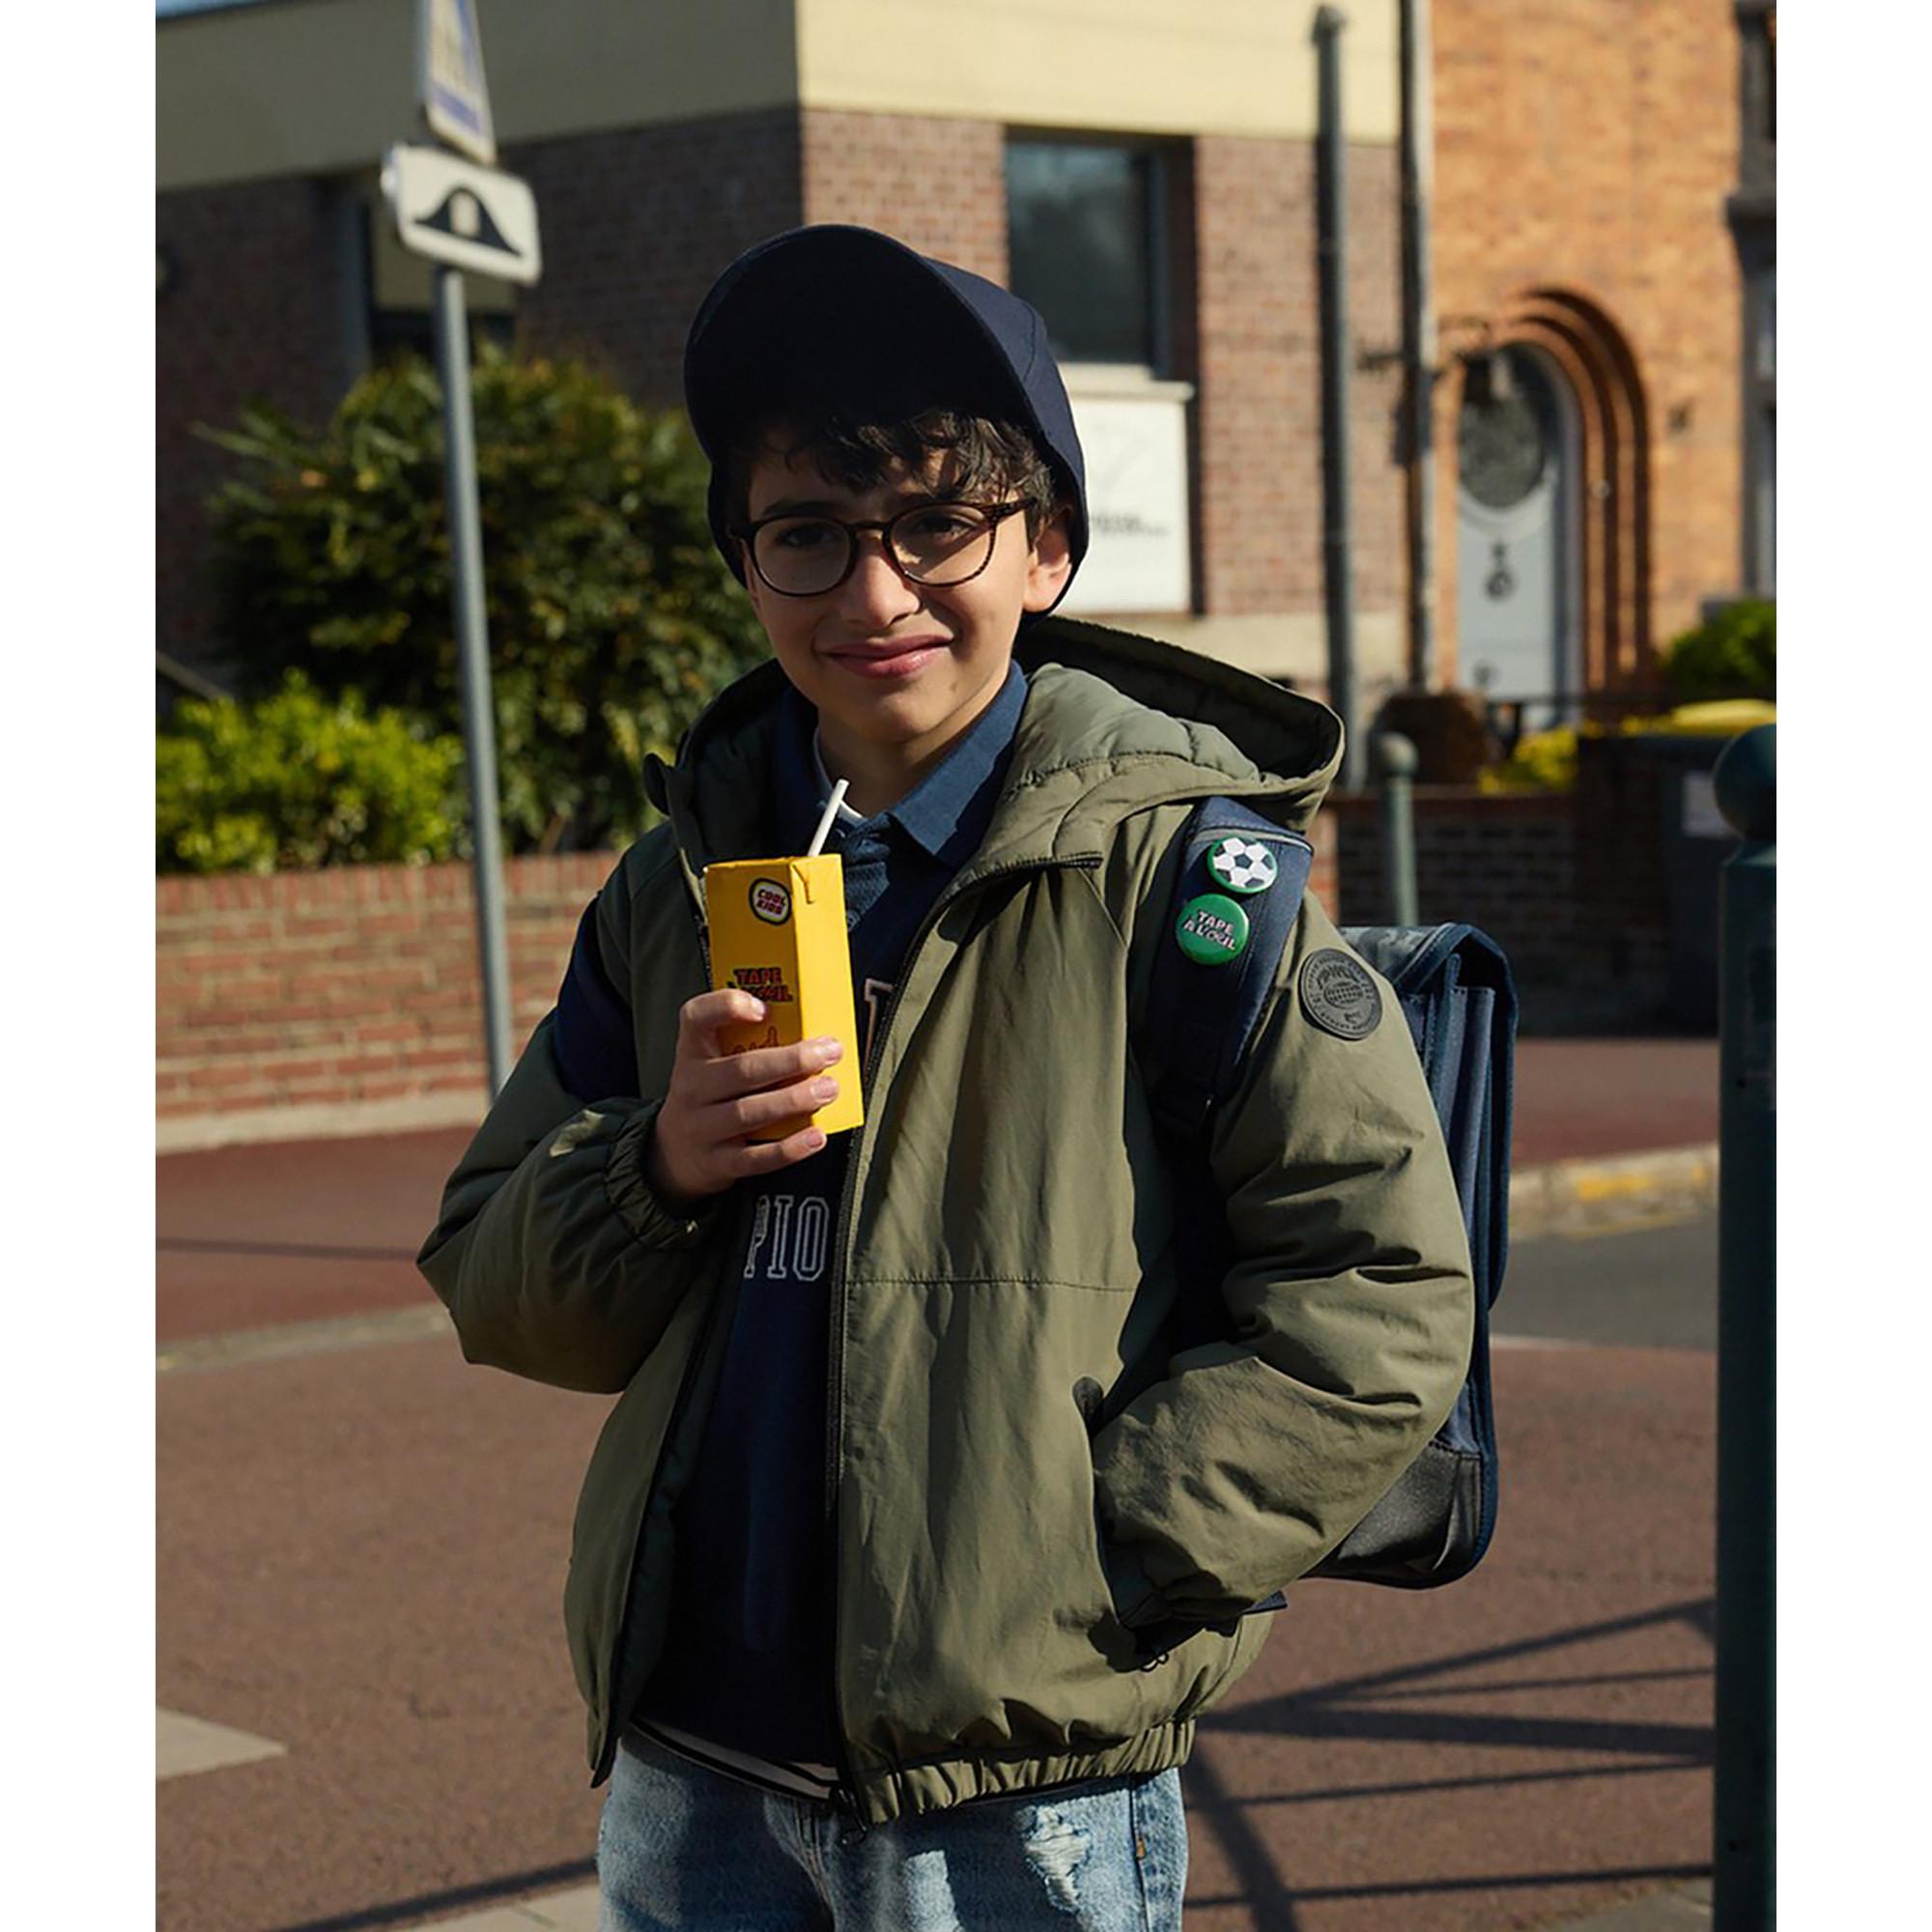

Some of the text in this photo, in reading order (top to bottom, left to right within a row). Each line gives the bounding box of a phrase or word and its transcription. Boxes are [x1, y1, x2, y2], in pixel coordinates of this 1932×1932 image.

[757, 889, 785, 905] COOL
[1198, 911, 1236, 935] TAPE
[733, 967, 781, 985] TAPE
